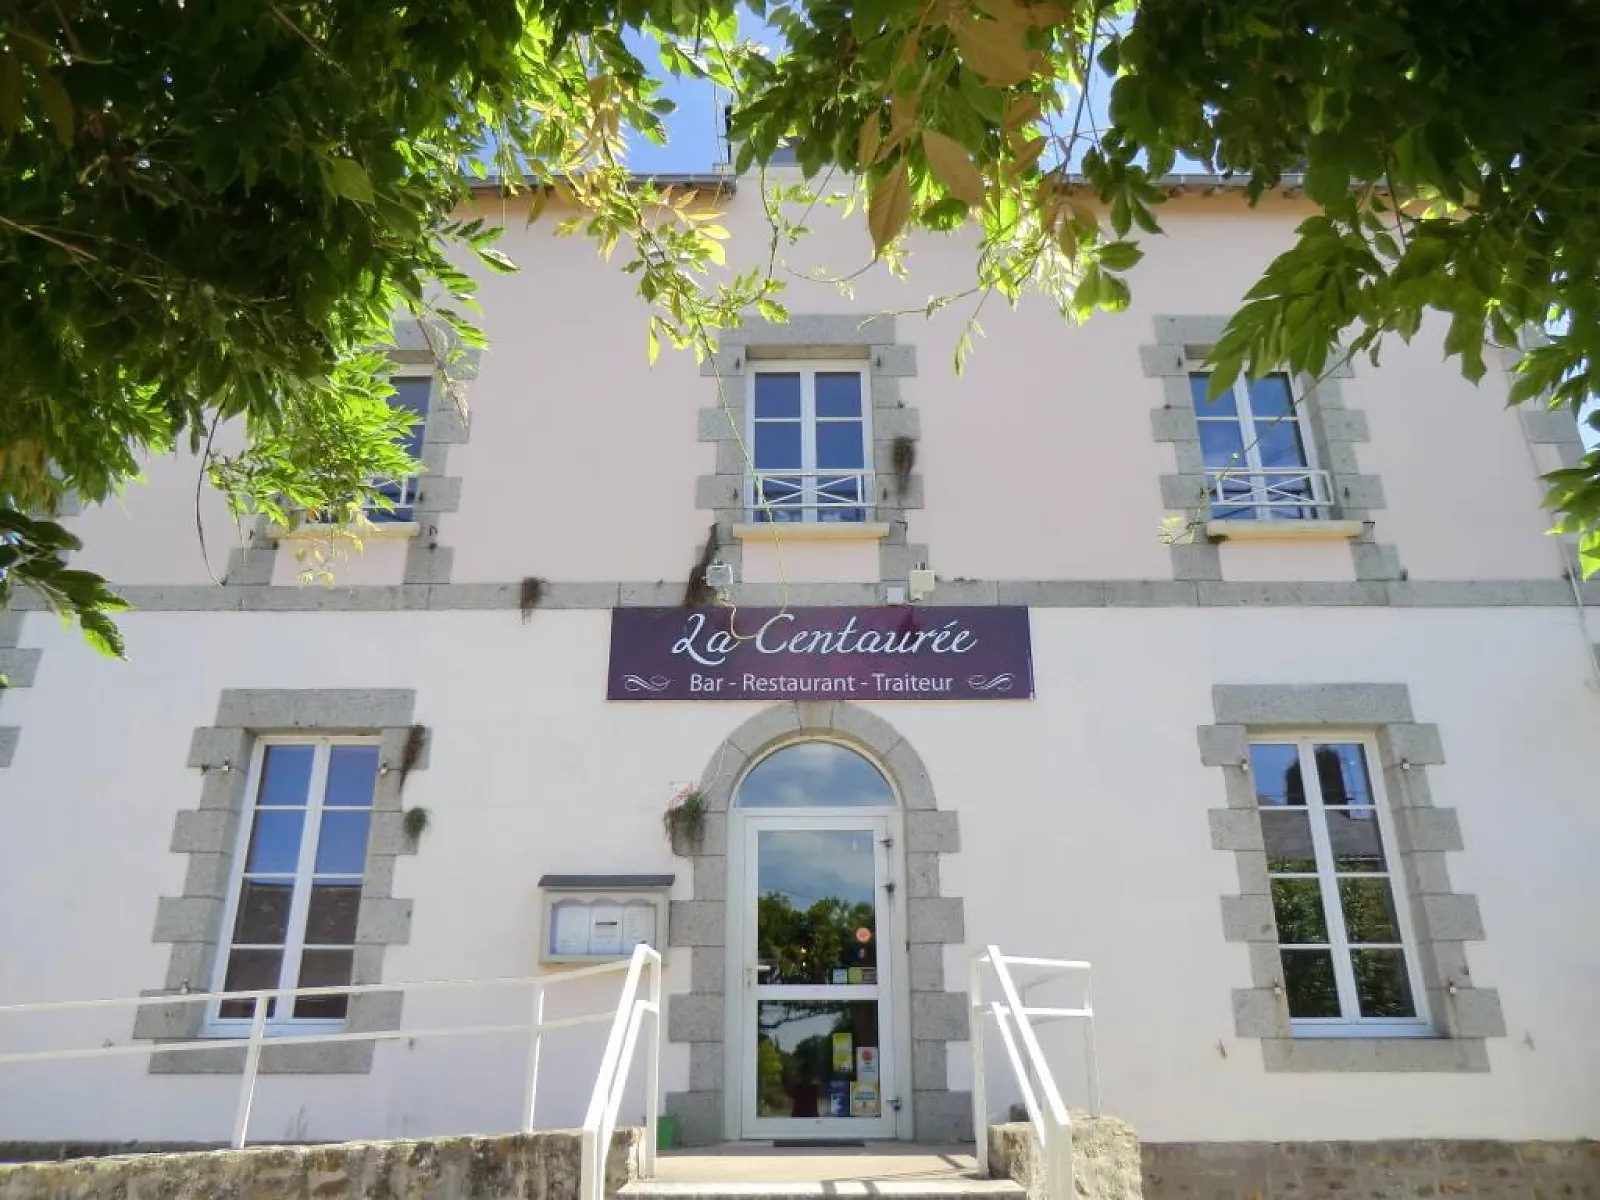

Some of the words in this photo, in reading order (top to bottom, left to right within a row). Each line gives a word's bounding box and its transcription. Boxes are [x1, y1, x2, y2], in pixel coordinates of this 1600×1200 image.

[671, 612, 737, 666] La
[755, 612, 978, 656] Centaurée
[689, 673, 723, 692] Bar
[743, 673, 856, 692] Restaurant
[872, 673, 953, 692] Traiteur
